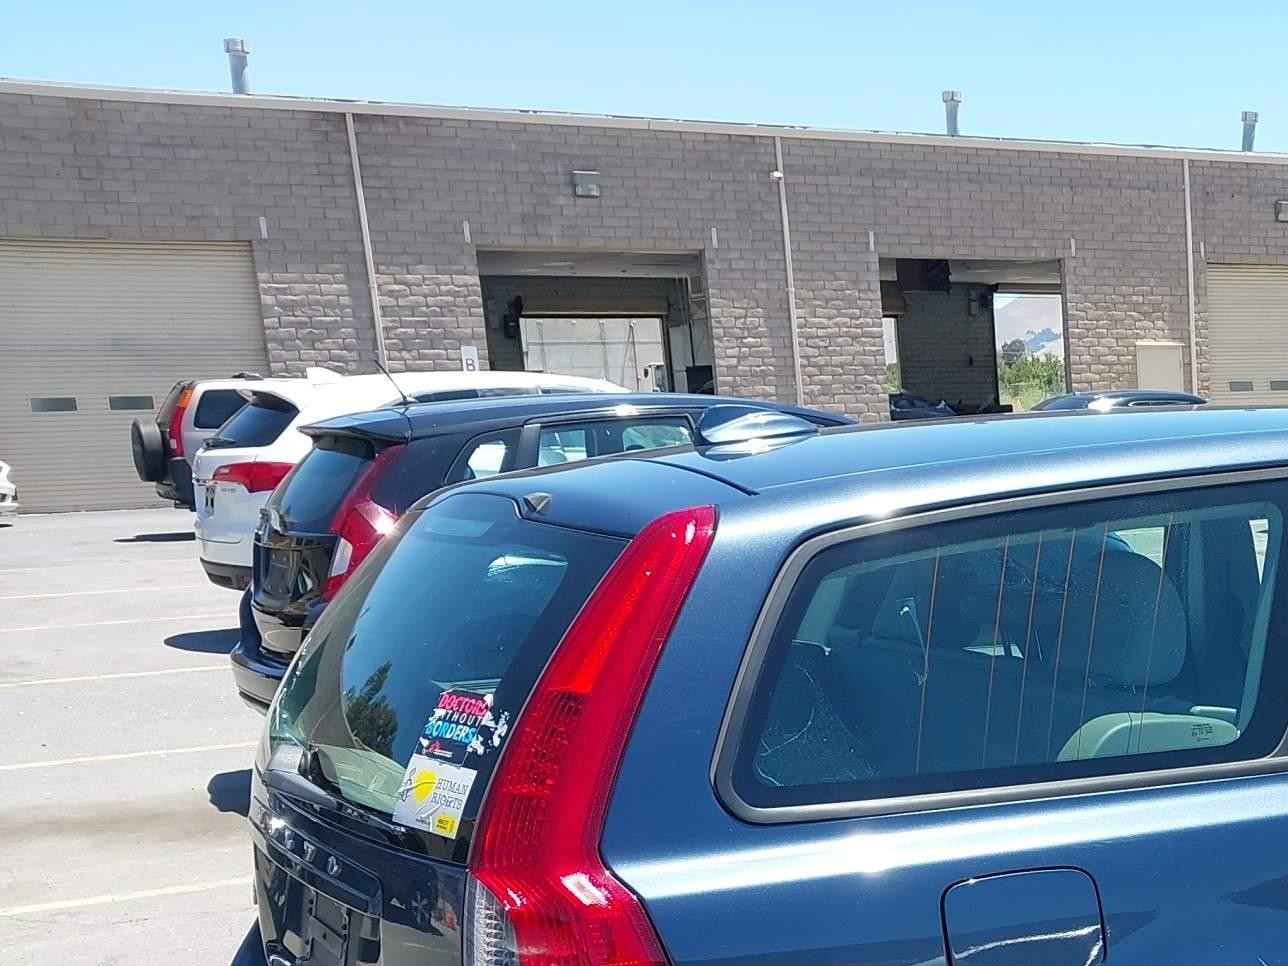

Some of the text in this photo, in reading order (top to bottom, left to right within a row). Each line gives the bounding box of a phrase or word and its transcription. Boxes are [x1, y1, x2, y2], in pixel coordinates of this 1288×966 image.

[466, 359, 475, 371] B
[434, 778, 469, 798] HUMAN
[431, 791, 463, 810] RIGHTS
